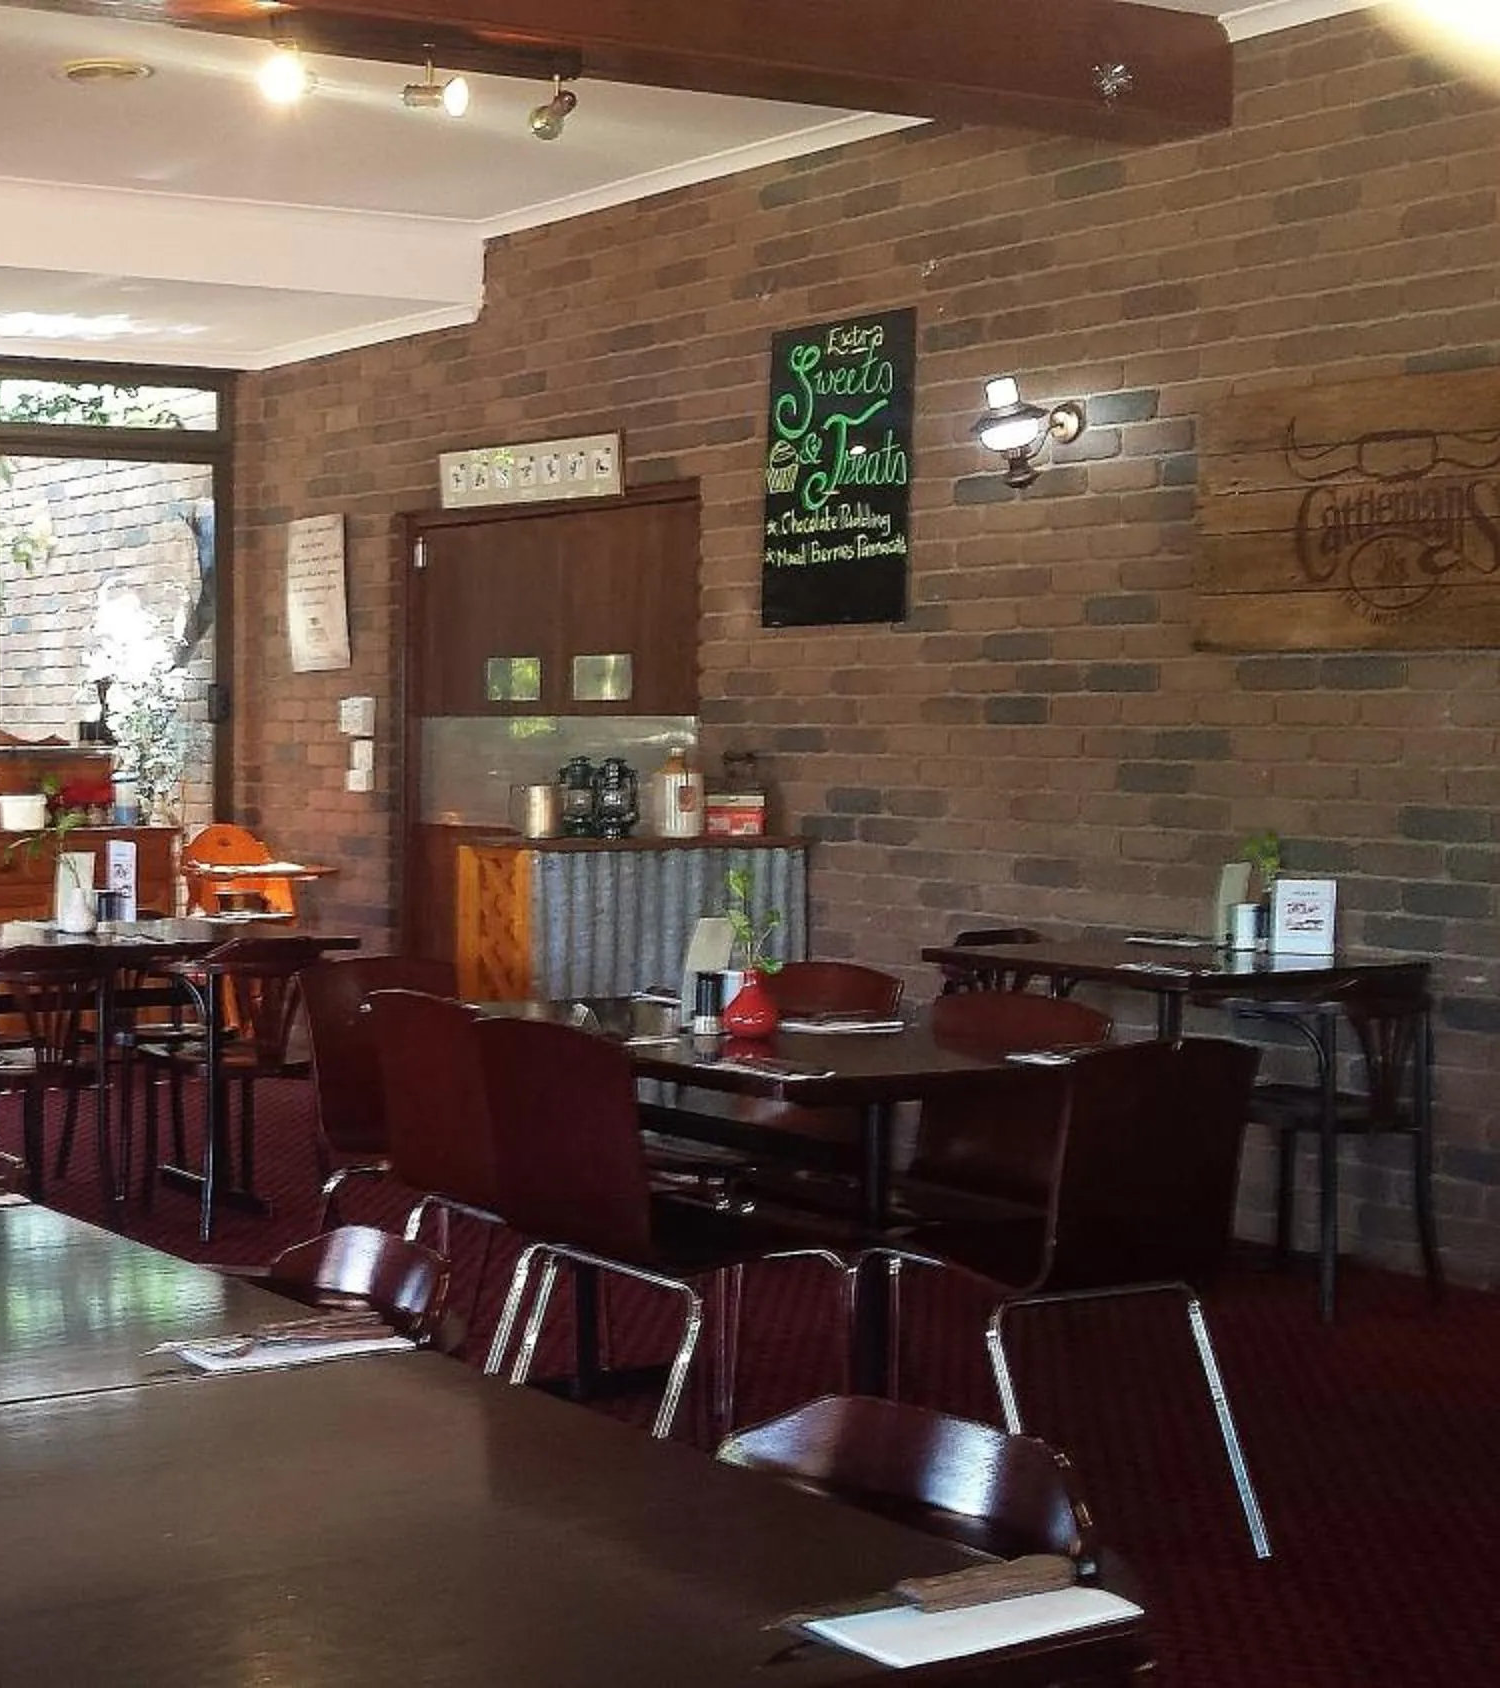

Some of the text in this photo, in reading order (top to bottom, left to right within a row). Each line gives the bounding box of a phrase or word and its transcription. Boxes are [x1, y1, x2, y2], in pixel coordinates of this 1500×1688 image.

[827, 324, 884, 351] Extra
[776, 345, 893, 440] Sweets
[799, 398, 907, 510] & Treats
[781, 501, 891, 537] Chocolate Pudding
